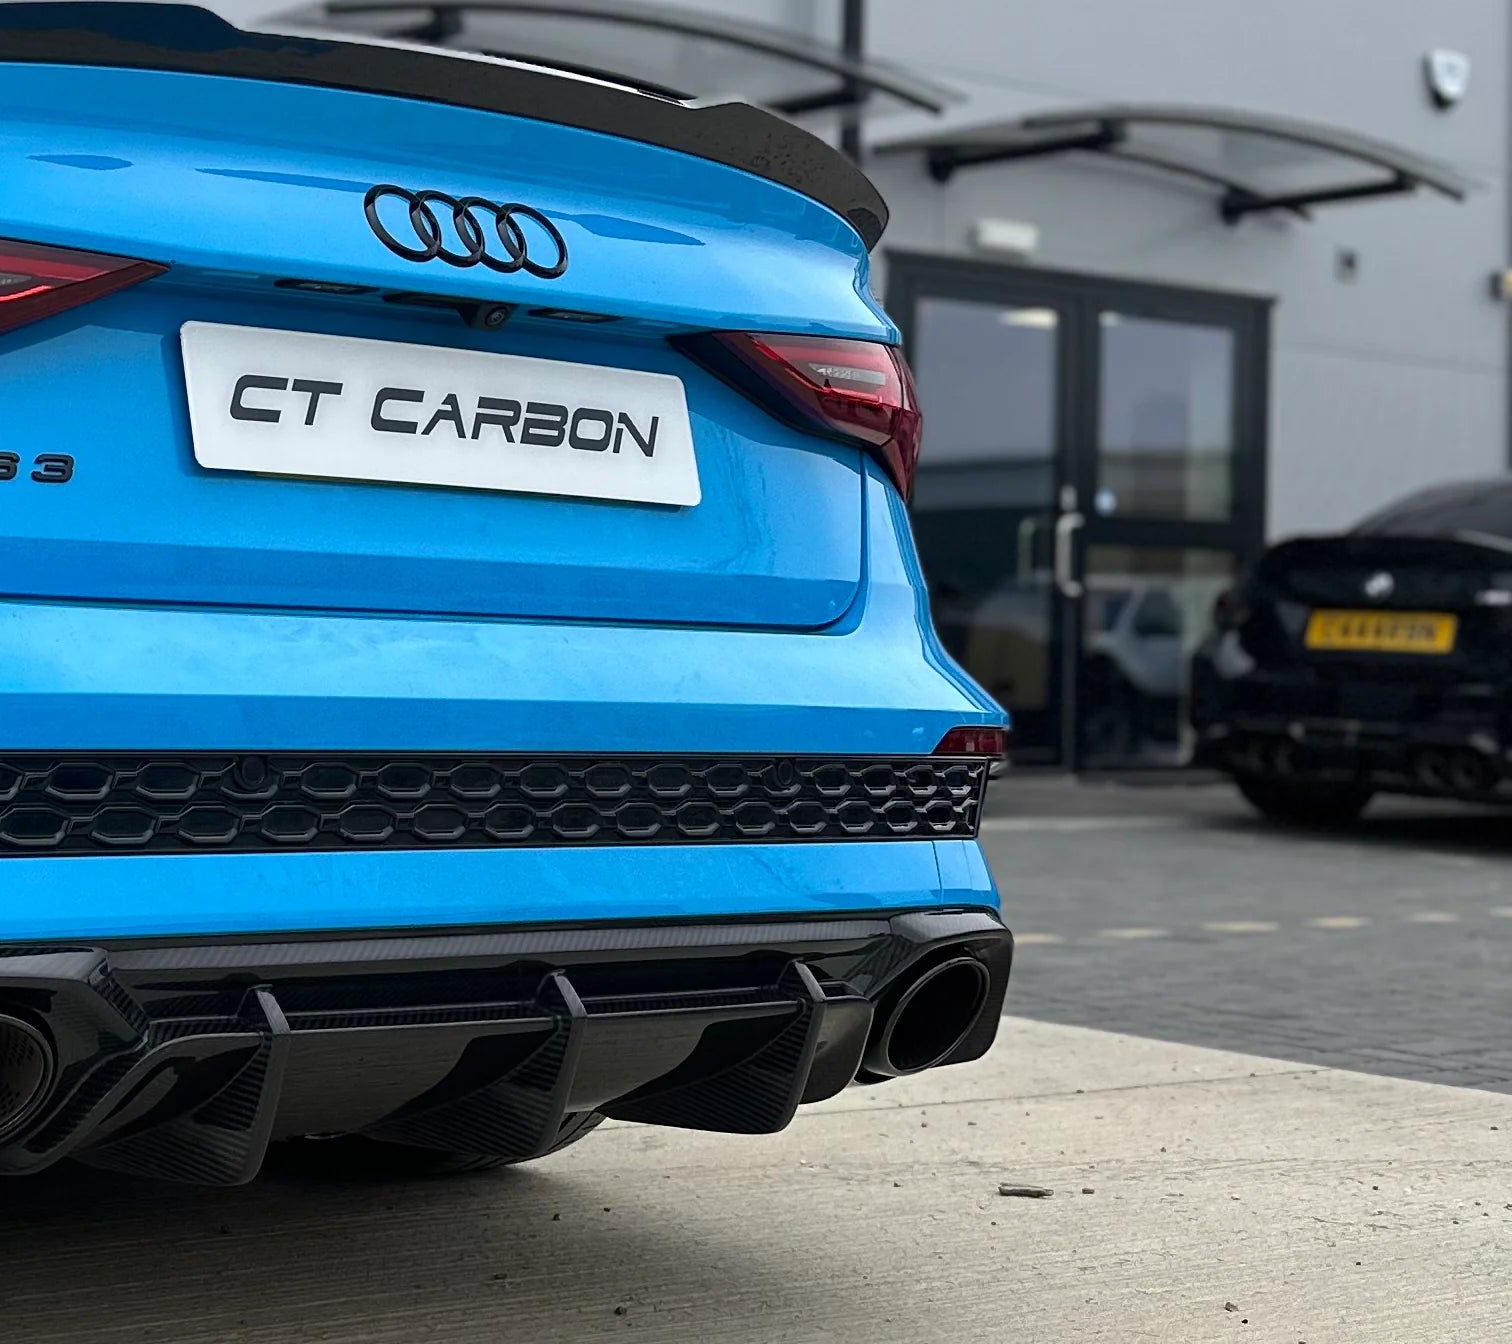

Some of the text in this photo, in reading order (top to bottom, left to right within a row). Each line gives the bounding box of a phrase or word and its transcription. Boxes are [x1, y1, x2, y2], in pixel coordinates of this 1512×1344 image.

[230, 374, 659, 457] CT CARBON
[31, 453, 75, 484] 3
